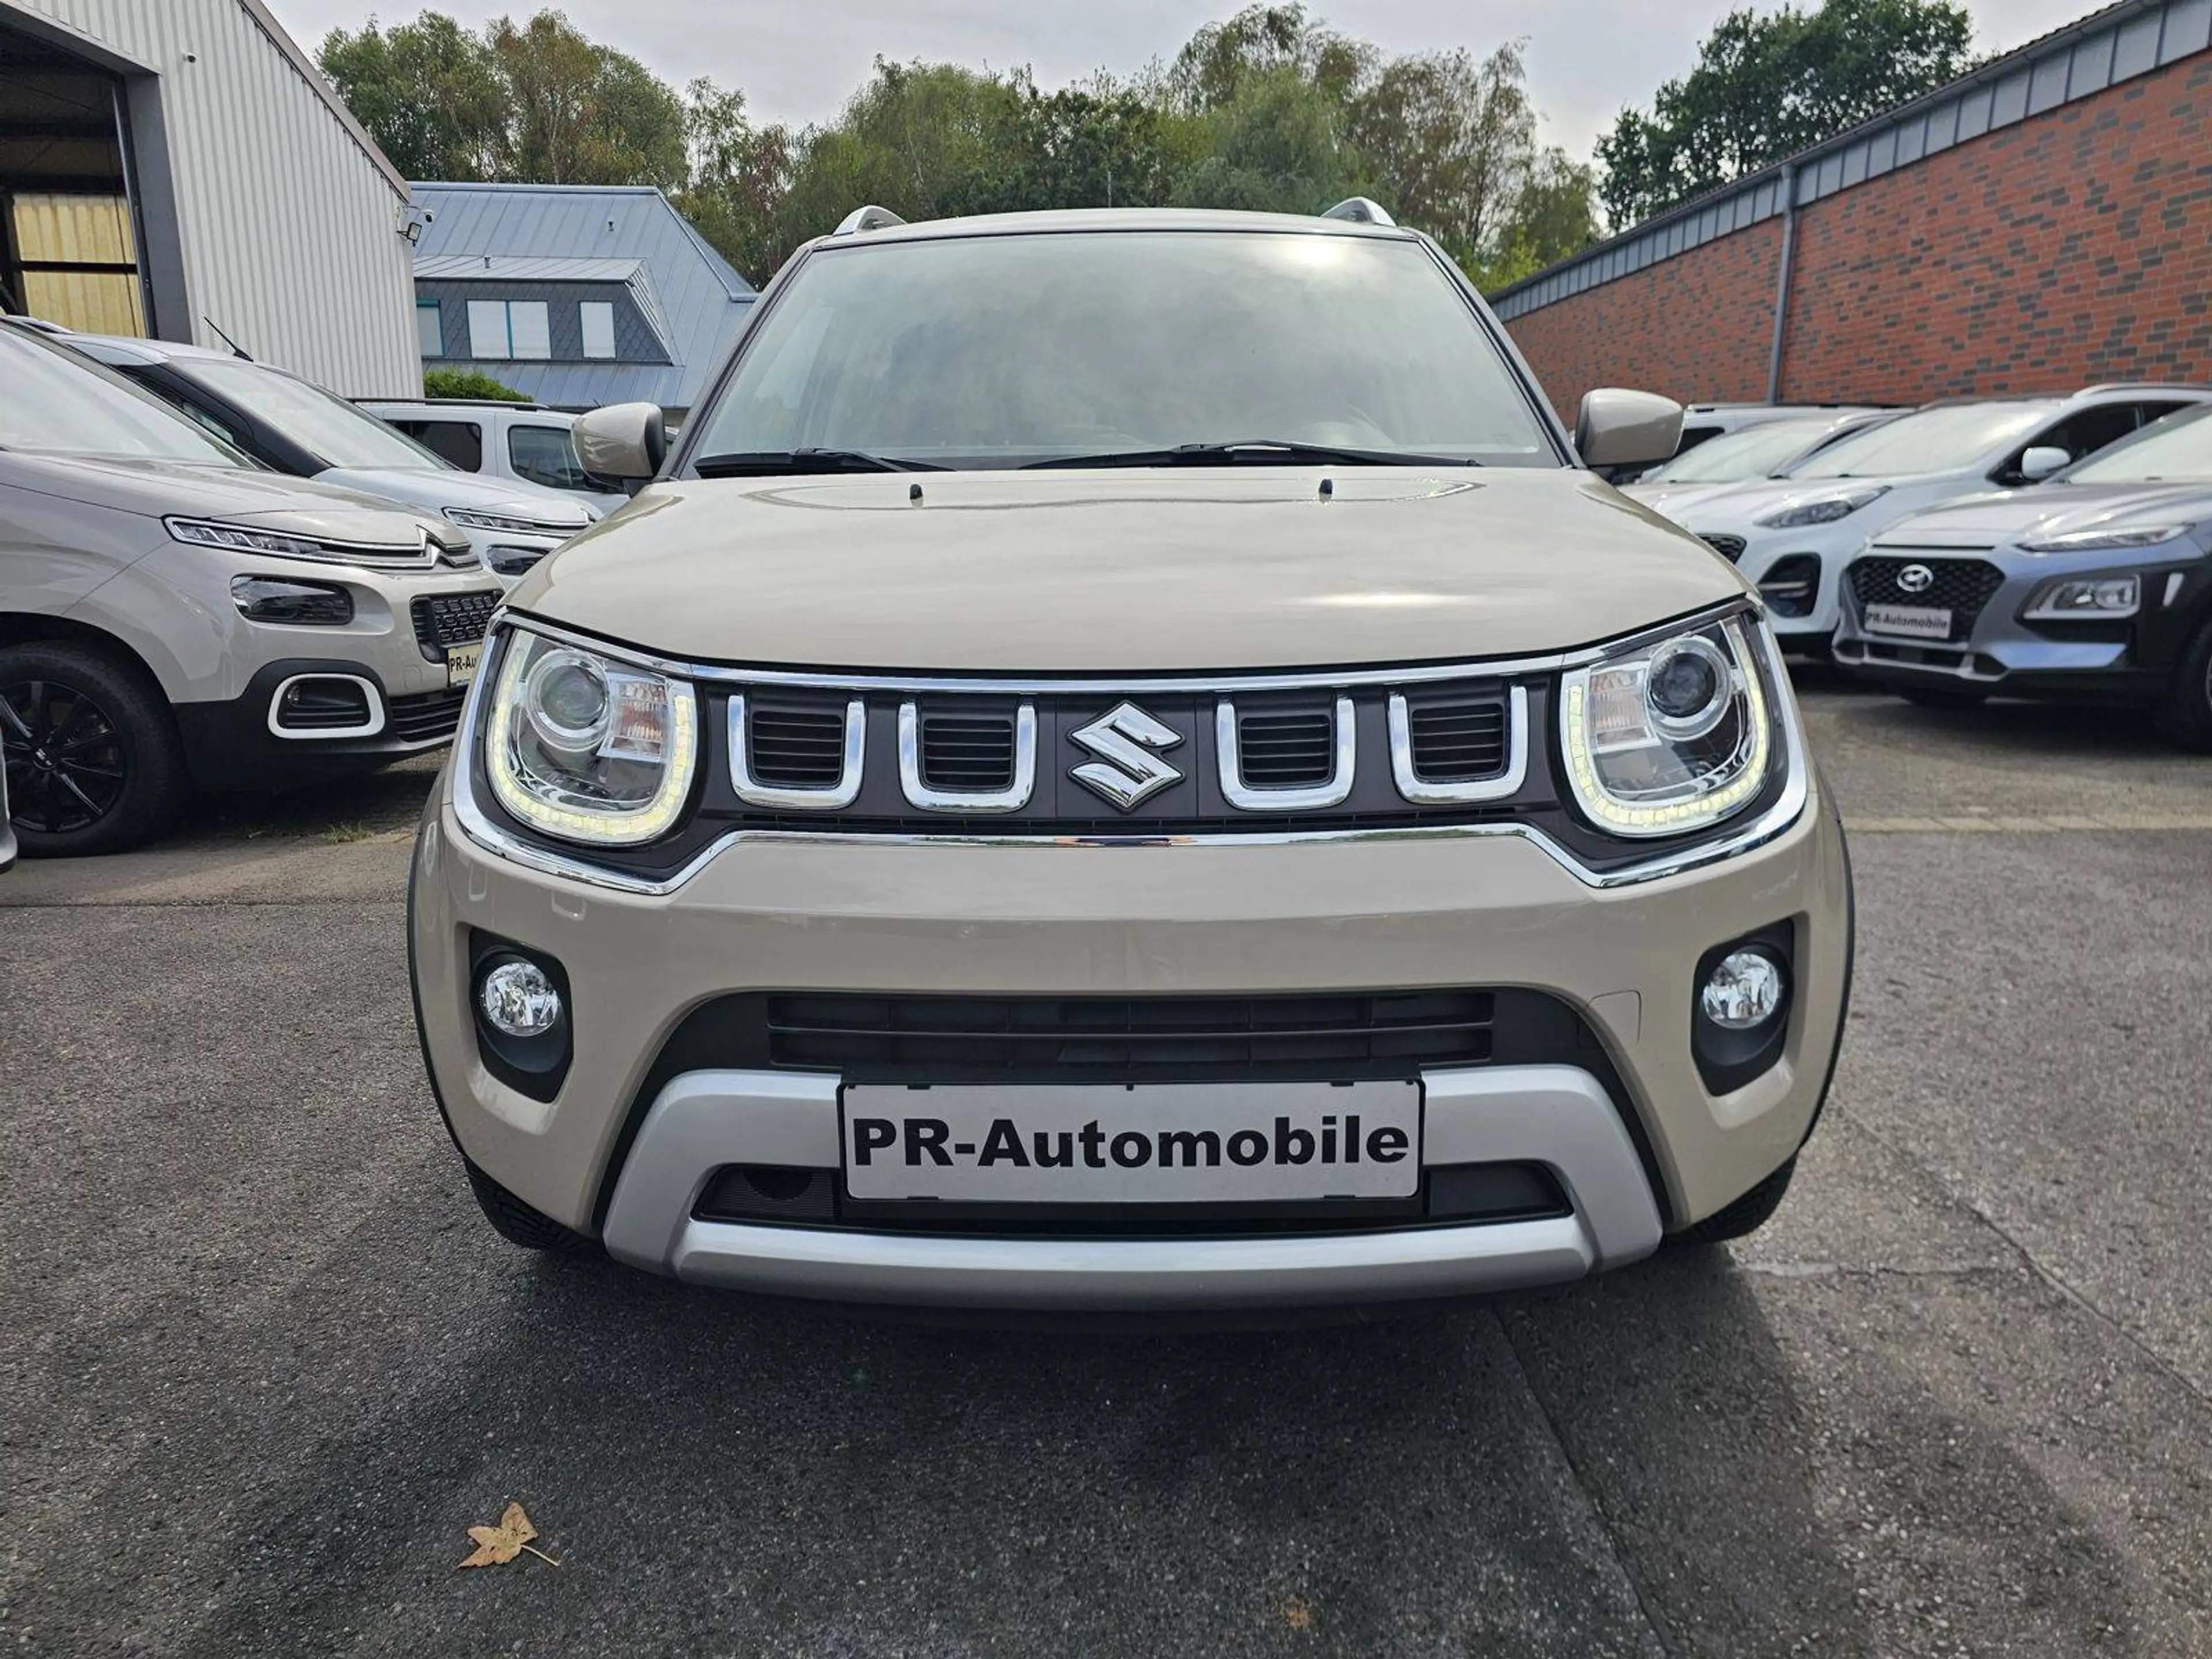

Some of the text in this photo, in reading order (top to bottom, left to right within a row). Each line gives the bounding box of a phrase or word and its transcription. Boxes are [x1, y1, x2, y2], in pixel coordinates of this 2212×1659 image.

[1866, 611, 1948, 629] PR-Automobile
[449, 654, 479, 673] PR-Au
[853, 1115, 1409, 1168] PR-Automobile
